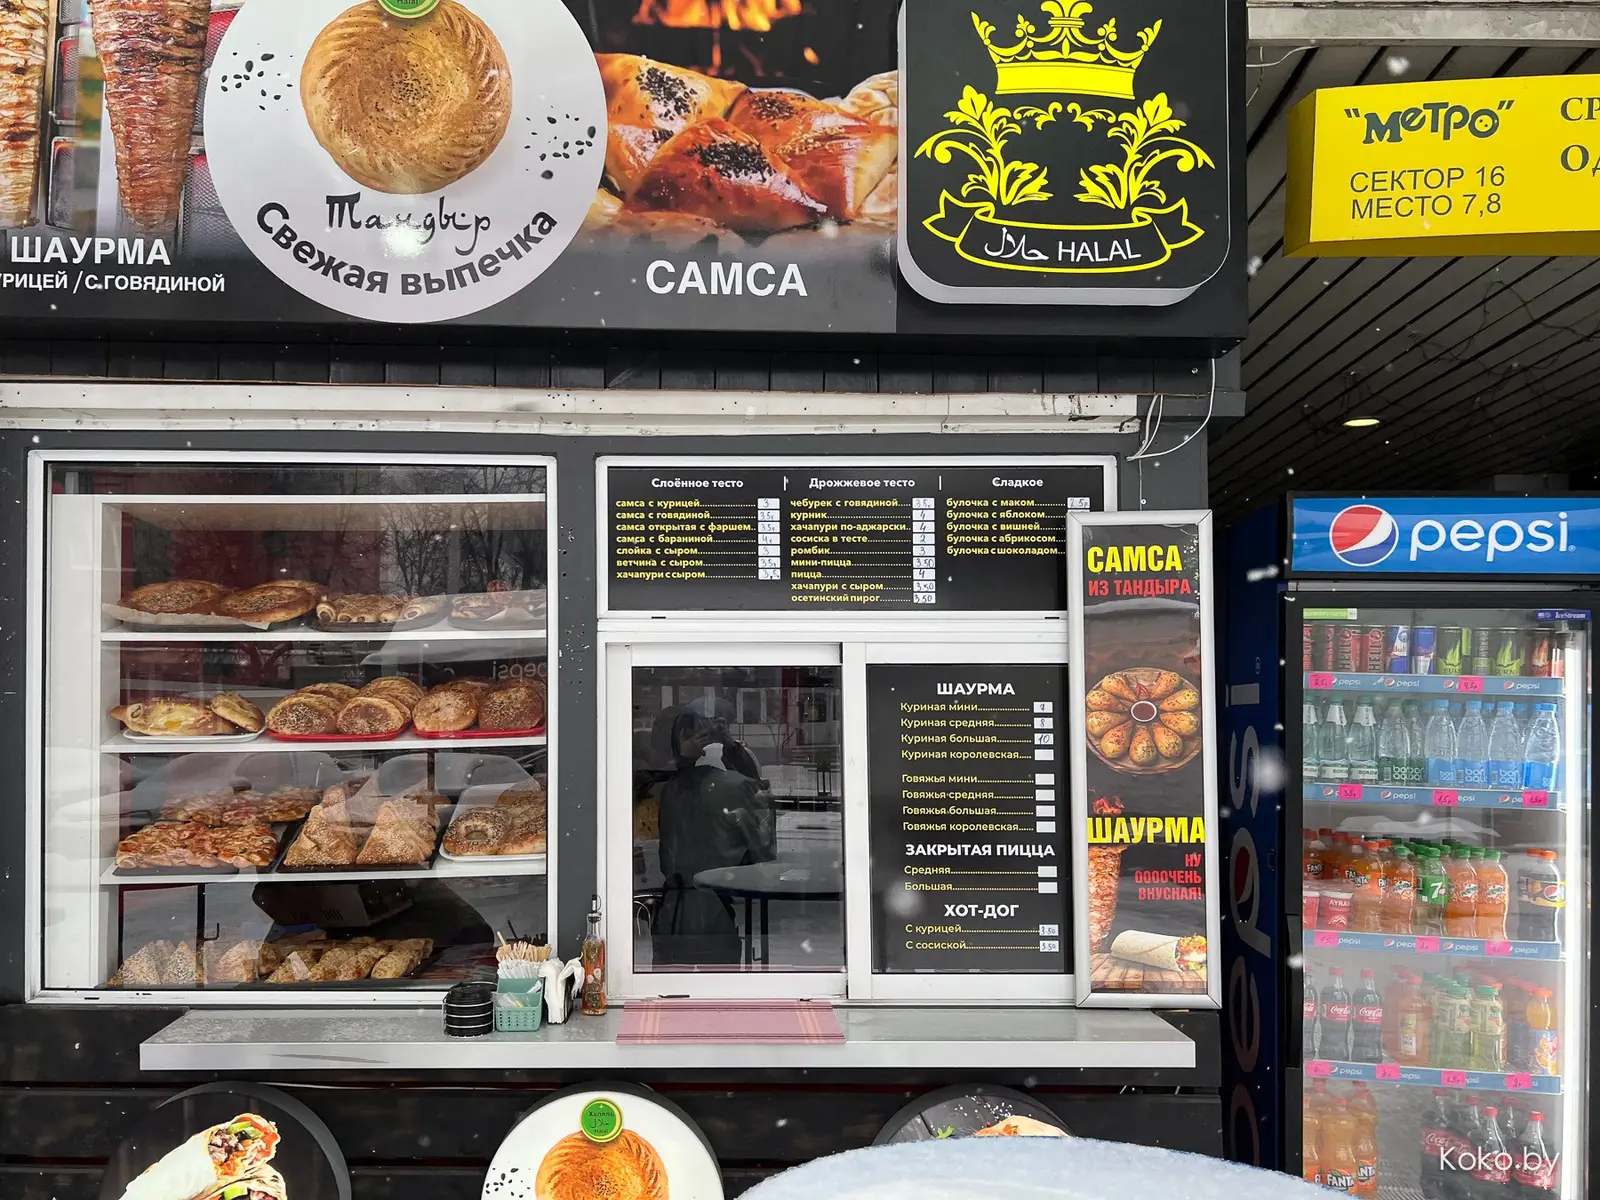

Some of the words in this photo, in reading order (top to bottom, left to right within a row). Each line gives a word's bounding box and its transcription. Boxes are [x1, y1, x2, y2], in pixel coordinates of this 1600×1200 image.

[1350, 167, 1464, 193] СЕКТОР
[1476, 166, 1505, 187] 16
[1352, 196, 1452, 219] МЕСТО
[1463, 193, 1501, 217] 7,8
[257, 202, 388, 294] Свежая
[401, 212, 558, 295] выпечка
[985, 227, 1049, 260] حلال
[11, 236, 171, 265] ШАУРМА
[1058, 239, 1141, 262] HALAL
[645, 260, 809, 297] САМСА
[104, 274, 225, 294] ГОВЯДИНОЙ
[652, 478, 709, 488] Слоённое
[712, 479, 743, 488] тесто
[809, 478, 881, 489] Дрожжевое
[884, 479, 915, 487] тесто
[992, 478, 1043, 488] Сладкое
[657, 499, 700, 508] курицей
[791, 499, 832, 509] чебурек
[844, 499, 898, 508] говядиной
[946, 498, 989, 509] булочка
[657, 511, 711, 521] говядиной
[791, 512, 827, 520] курник
[946, 510, 989, 520] булочка
[999, 510, 1046, 518] яблоком
[648, 524, 697, 532] открытая
[708, 522, 751, 532] фаршем
[791, 524, 838, 533] хачапури
[841, 524, 906, 533] по-аджарски
[946, 522, 989, 532] булочка
[1000, 522, 1040, 530] вишней
[658, 534, 712, 544] бараниной
[946, 534, 989, 544] булочка
[999, 534, 1056, 544] абрикосом
[1409, 511, 1568, 562] pepsi
[616, 546, 651, 554] слойка
[664, 548, 698, 556] сыром
[791, 546, 830, 556] ромбик
[946, 546, 989, 556] булочка
[997, 548, 1058, 556] шоколадом
[791, 559, 852, 567] мини-пицца
[1088, 545, 1182, 572] САМСА
[669, 560, 703, 568] сыром
[616, 571, 664, 580] хачапури
[671, 571, 706, 580] сыром
[791, 583, 838, 592] хачапури
[850, 583, 884, 592] сыром
[1088, 580, 1109, 596] ИЗ
[1114, 579, 1191, 597] ТАНДЫРА
[791, 594, 849, 602] осетинский
[850, 595, 880, 604] пирог
[1339, 679, 1361, 687] pepsi
[1516, 682, 1540, 690] pepsi
[937, 683, 1015, 695] ШАУРМА
[900, 702, 946, 713] Куриная
[900, 718, 946, 729] Куриная
[949, 720, 995, 729] средняя
[901, 734, 947, 745] Куриная
[950, 734, 997, 742] большая
[1037, 734, 1050, 744] 10
[901, 750, 947, 760] Куриная
[950, 751, 1019, 760] королевская
[902, 774, 945, 783] Говяжья
[902, 790, 946, 799] Говяжья
[949, 792, 994, 800] средняя
[1393, 791, 1416, 800] pepsi
[902, 806, 947, 815] Говяжья
[949, 806, 997, 815] большая
[903, 822, 947, 831] Говяжья
[950, 823, 1019, 832] королевская
[1087, 816, 1205, 844] ШАУРМА
[905, 844, 992, 856] ЗАКРЫТАЯ
[997, 844, 1055, 858] ПИЦЦА
[1185, 854, 1202, 867] НУ
[904, 866, 950, 876] Средняя
[905, 882, 952, 891] Большая
[1138, 887, 1202, 900] ВКУСНАЯ!
[944, 904, 1019, 918] ХОТ-ДОГ
[916, 925, 962, 936] курицей
[916, 941, 966, 949] сосиской
